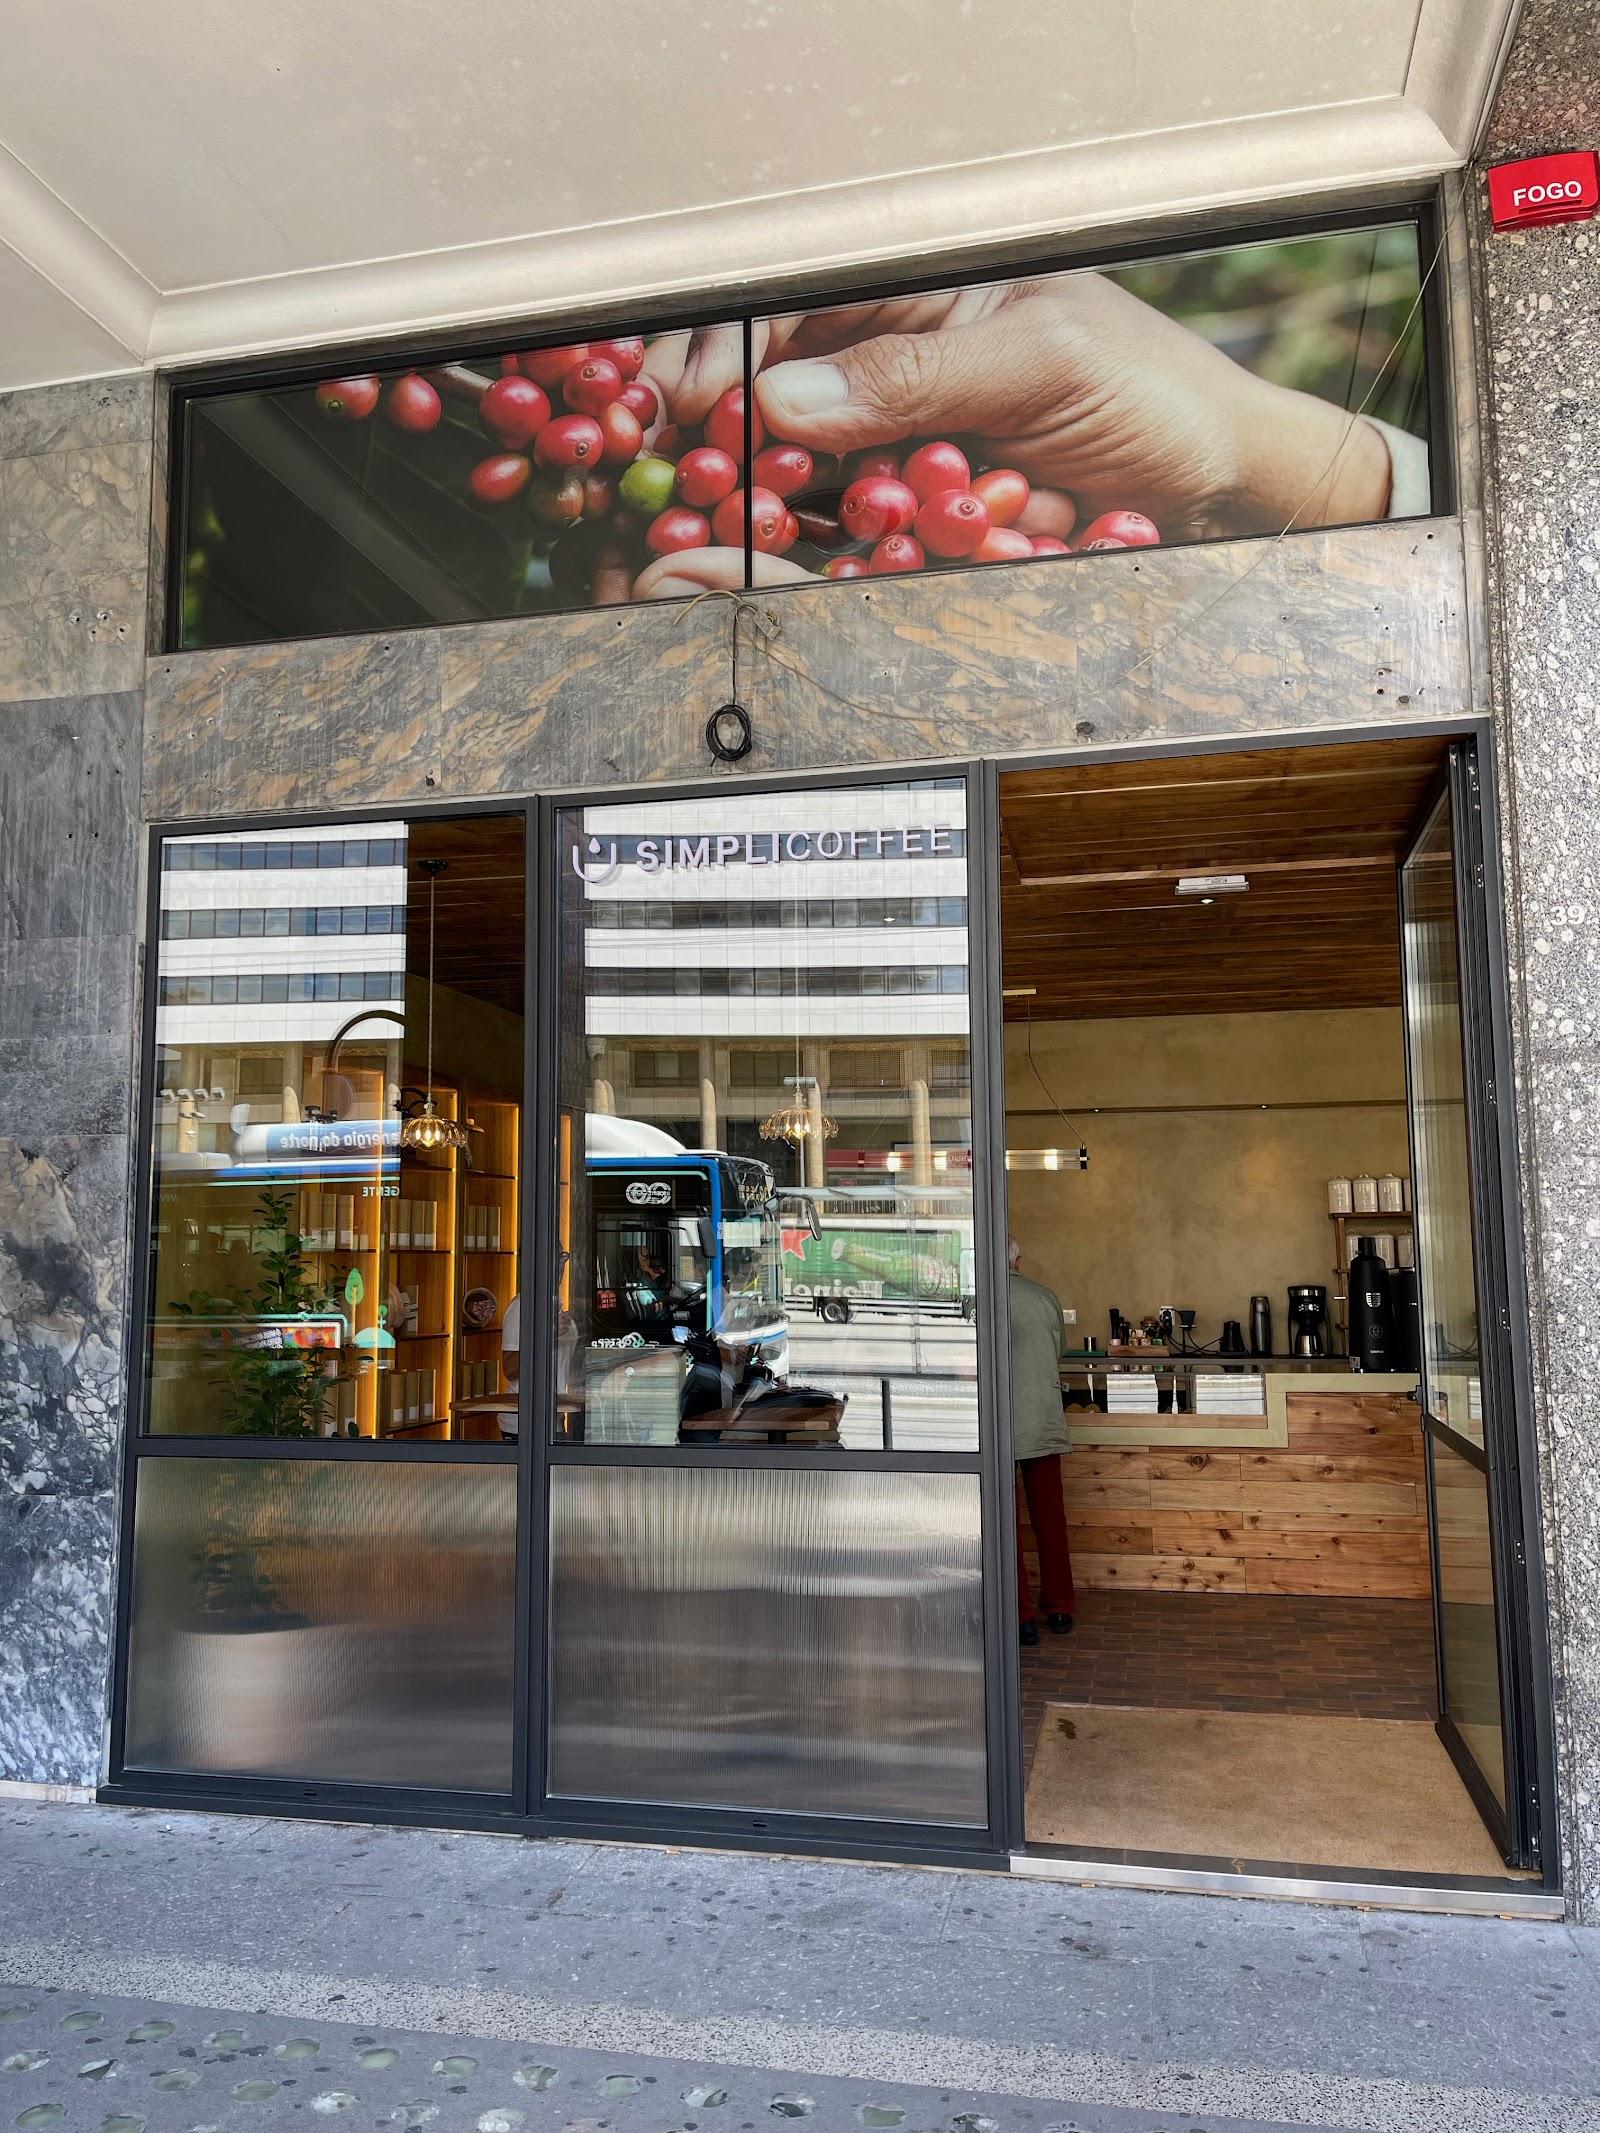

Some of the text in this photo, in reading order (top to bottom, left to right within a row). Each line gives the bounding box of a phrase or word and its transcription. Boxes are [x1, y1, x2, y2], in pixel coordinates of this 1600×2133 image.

[1513, 180, 1582, 206] FOGO
[635, 823, 952, 871] SIMPLICOFFEE
[1550, 906, 1585, 925] 39
